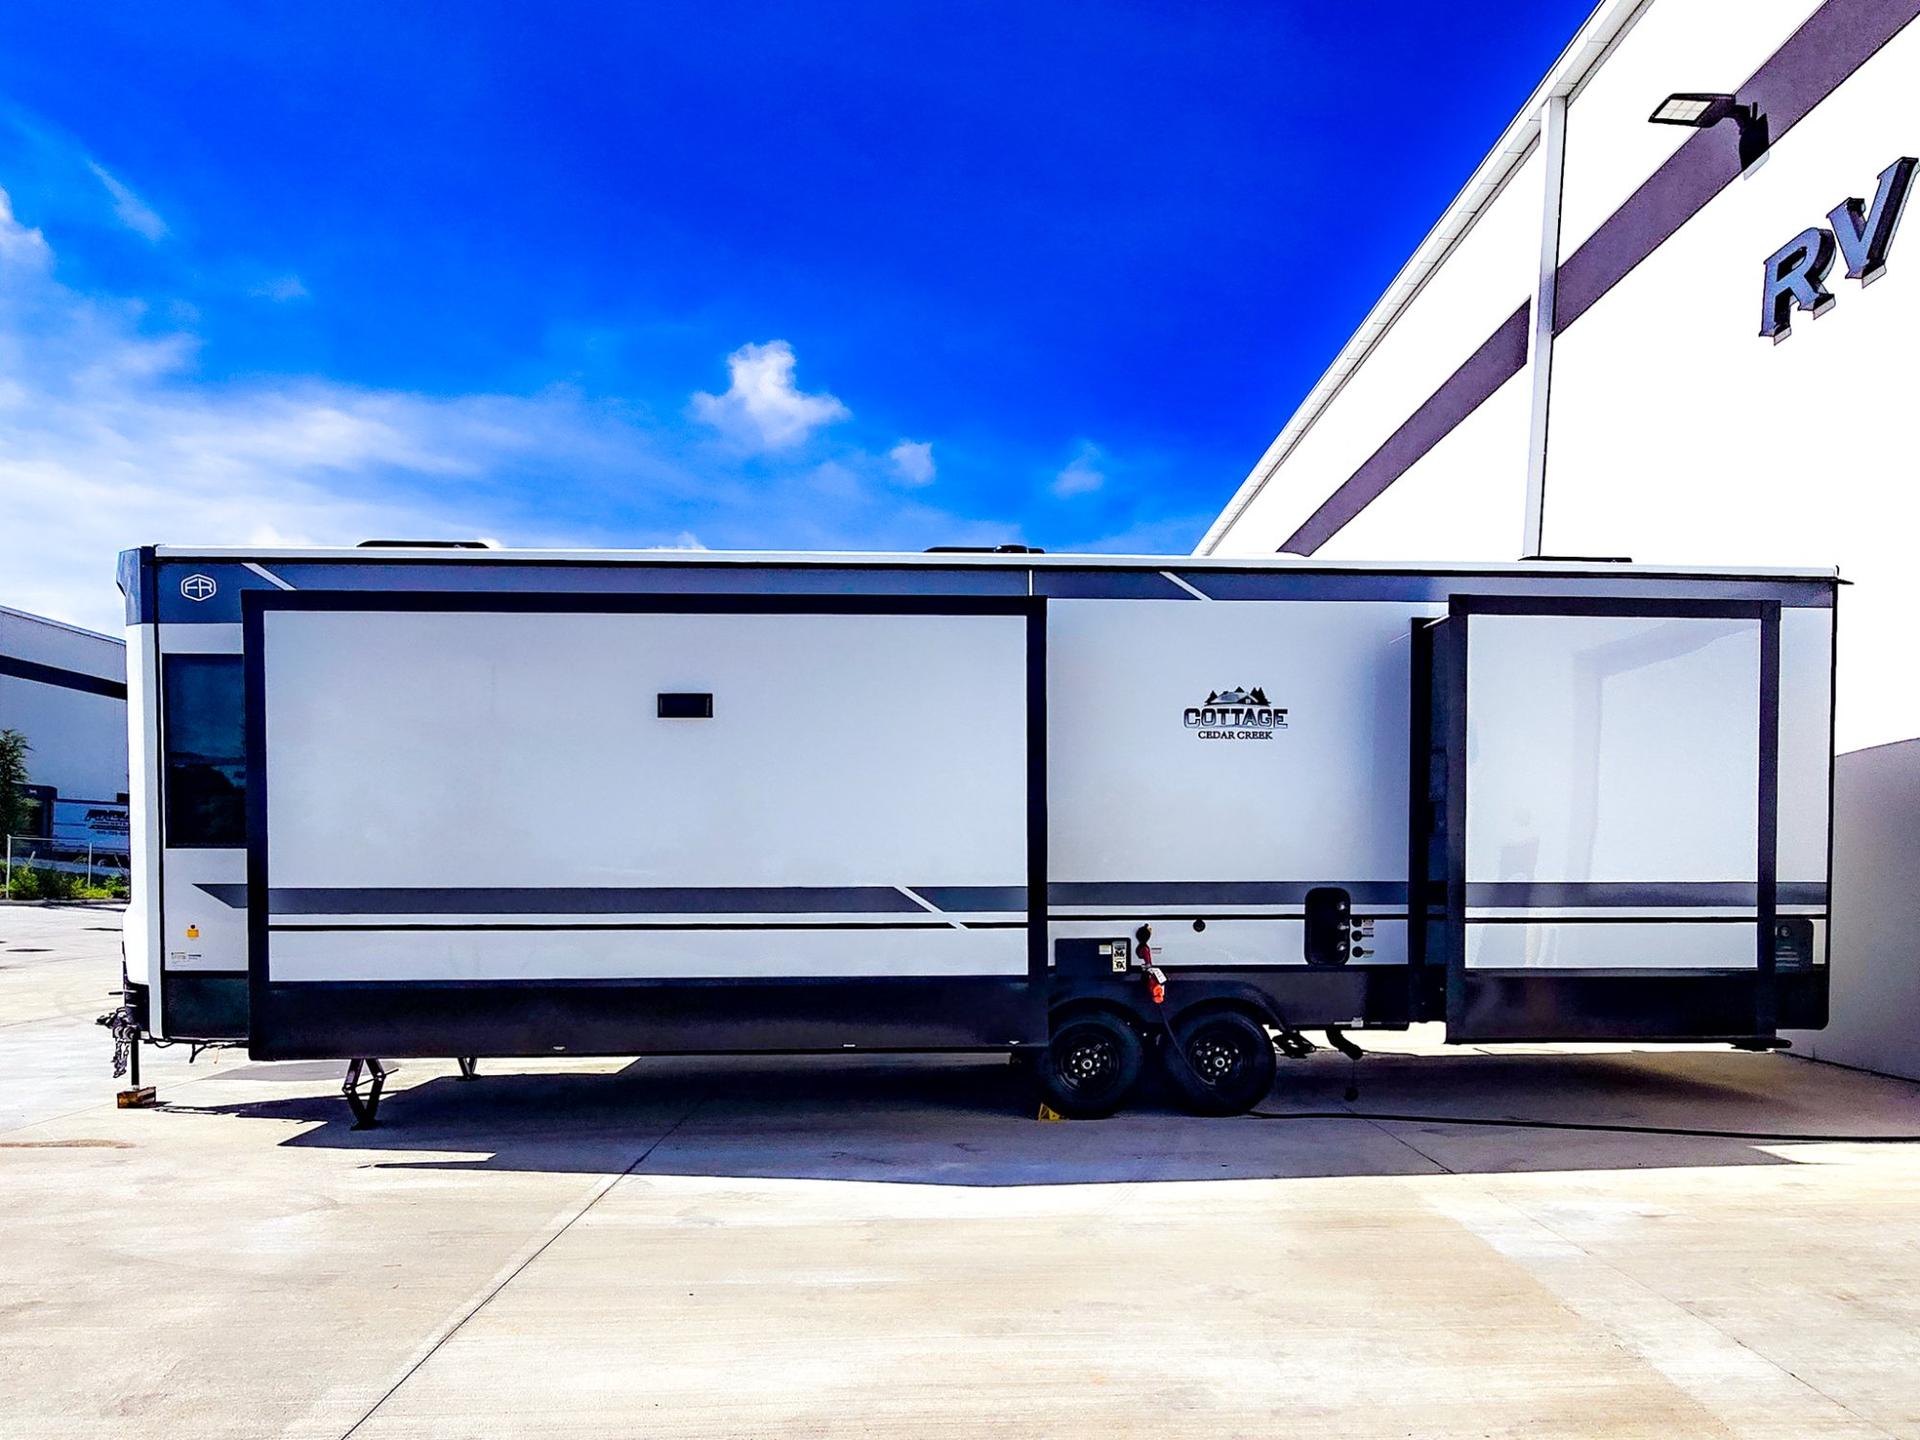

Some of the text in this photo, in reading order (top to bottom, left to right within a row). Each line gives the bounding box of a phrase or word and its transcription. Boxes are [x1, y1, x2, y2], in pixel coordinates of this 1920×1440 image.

[1758, 156, 1919, 343] RV
[184, 577, 213, 598] FR
[1183, 708, 1289, 729] COTTAGE
[1198, 731, 1273, 740] CEDAR CREEK
